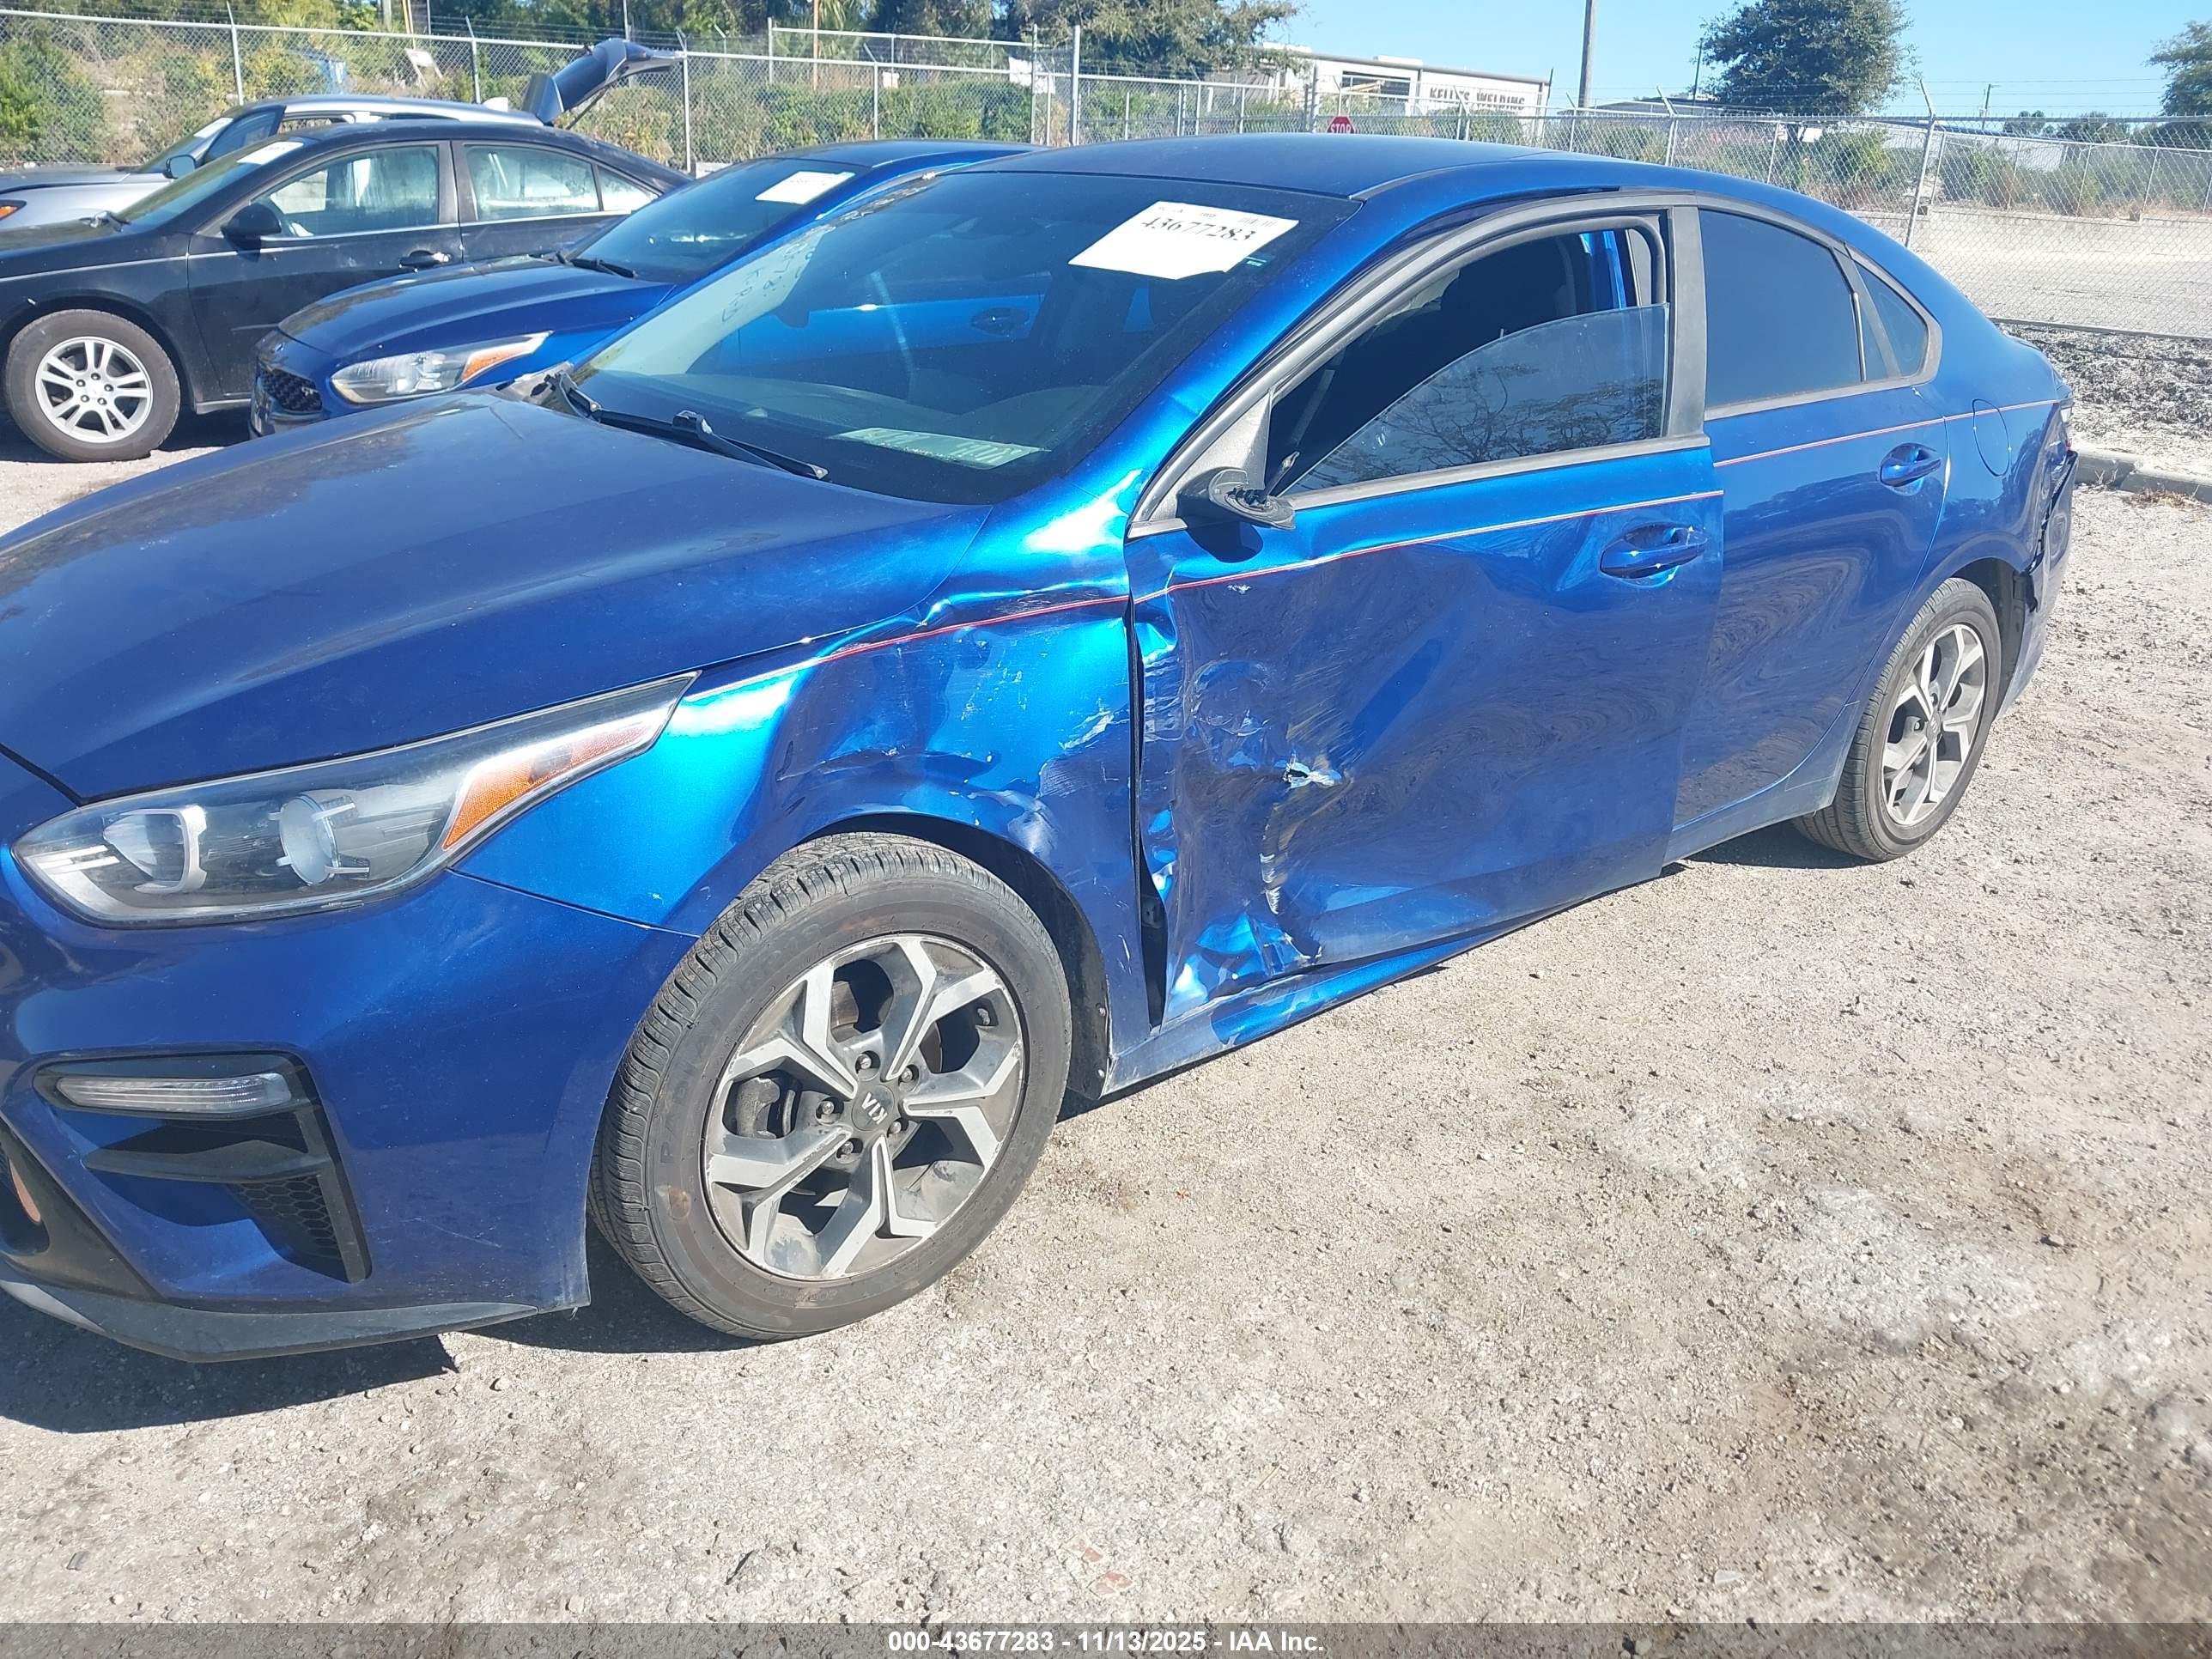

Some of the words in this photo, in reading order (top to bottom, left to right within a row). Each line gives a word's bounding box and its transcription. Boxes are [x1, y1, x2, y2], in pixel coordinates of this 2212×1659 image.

[1476, 92, 1525, 110] WELDING
[1331, 123, 1352, 134] STOP
[1141, 216, 1256, 242] 43677283
[861, 1091, 888, 1125] KIA
